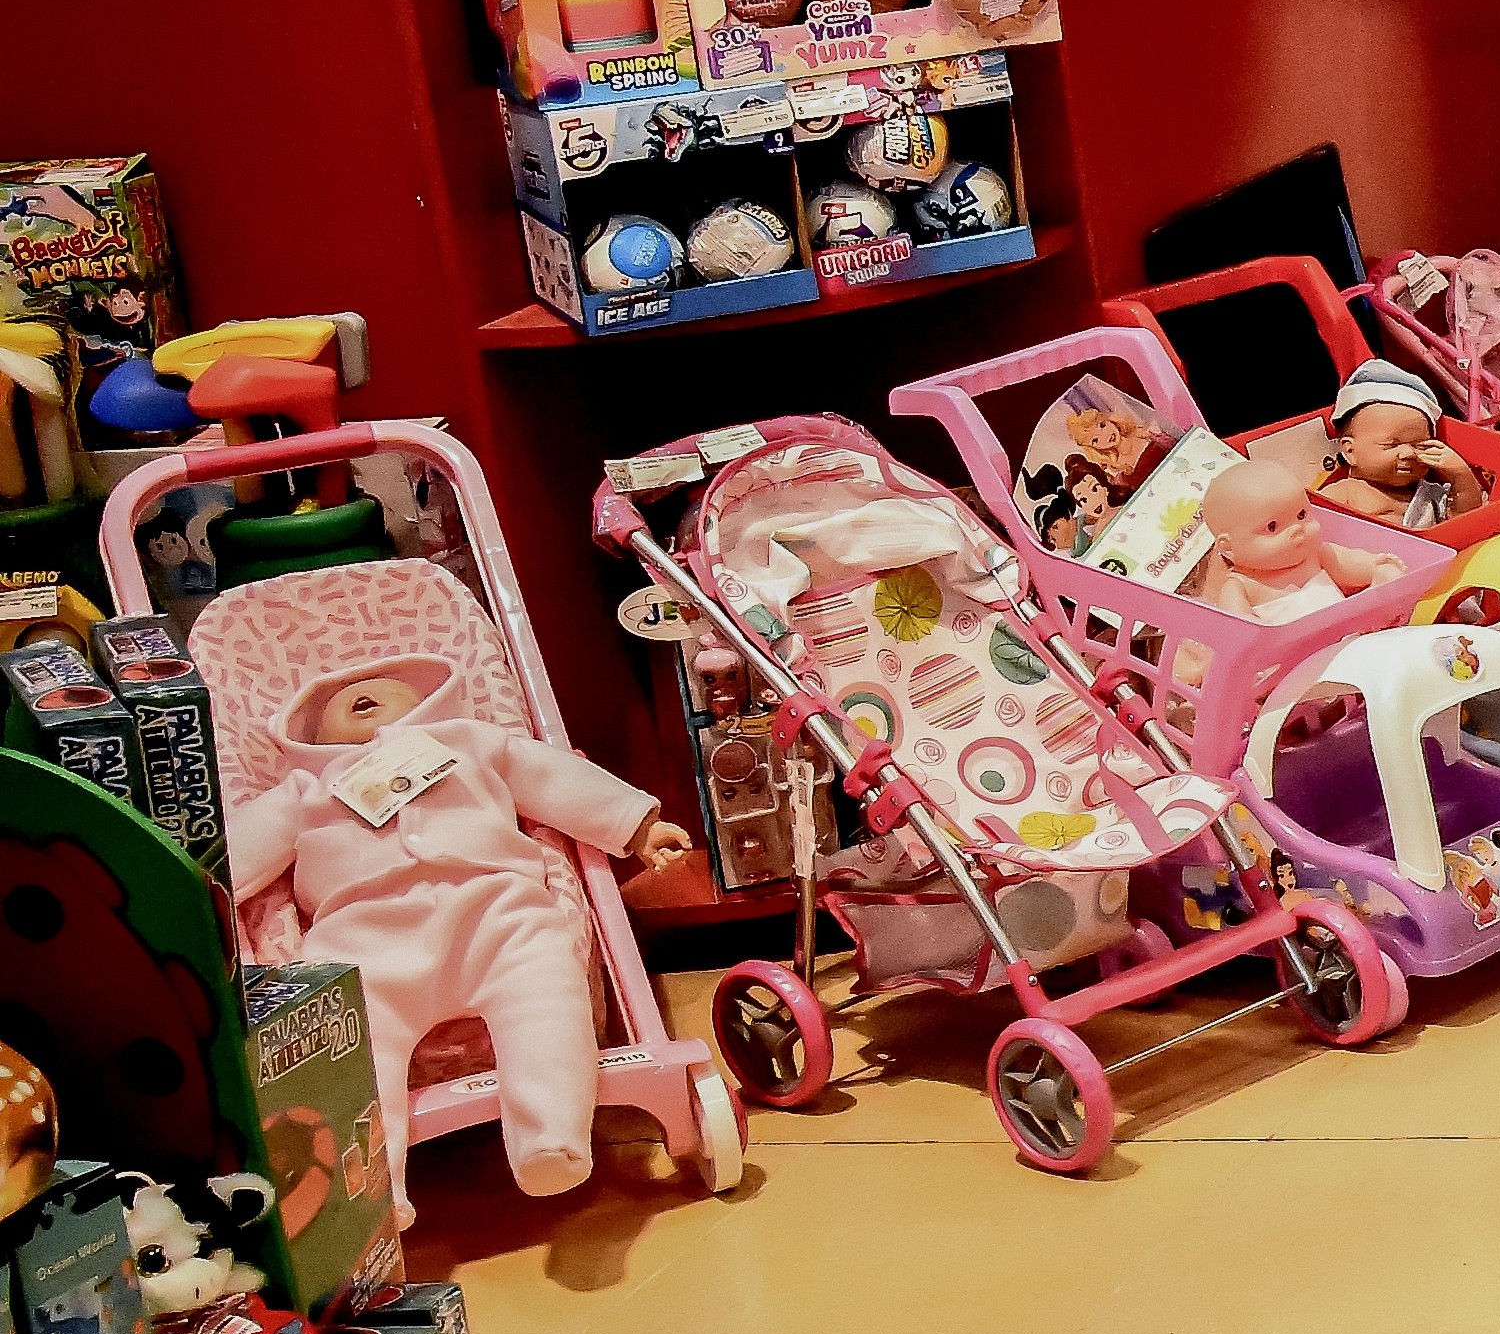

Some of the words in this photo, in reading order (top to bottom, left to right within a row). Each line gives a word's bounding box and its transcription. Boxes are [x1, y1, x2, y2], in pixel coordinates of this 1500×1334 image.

[713, 26, 763, 48] 30+
[589, 52, 676, 83] RAINBOW
[610, 69, 678, 91] SPRING
[774, 132, 784, 147] 9
[27, 254, 128, 289] MONKEYS
[818, 238, 911, 278] UNICORN
[597, 307, 629, 327] ICE
[631, 298, 672, 321] AGE
[174, 705, 218, 842] PALABRAS
[259, 986, 343, 1048] PALABRAS
